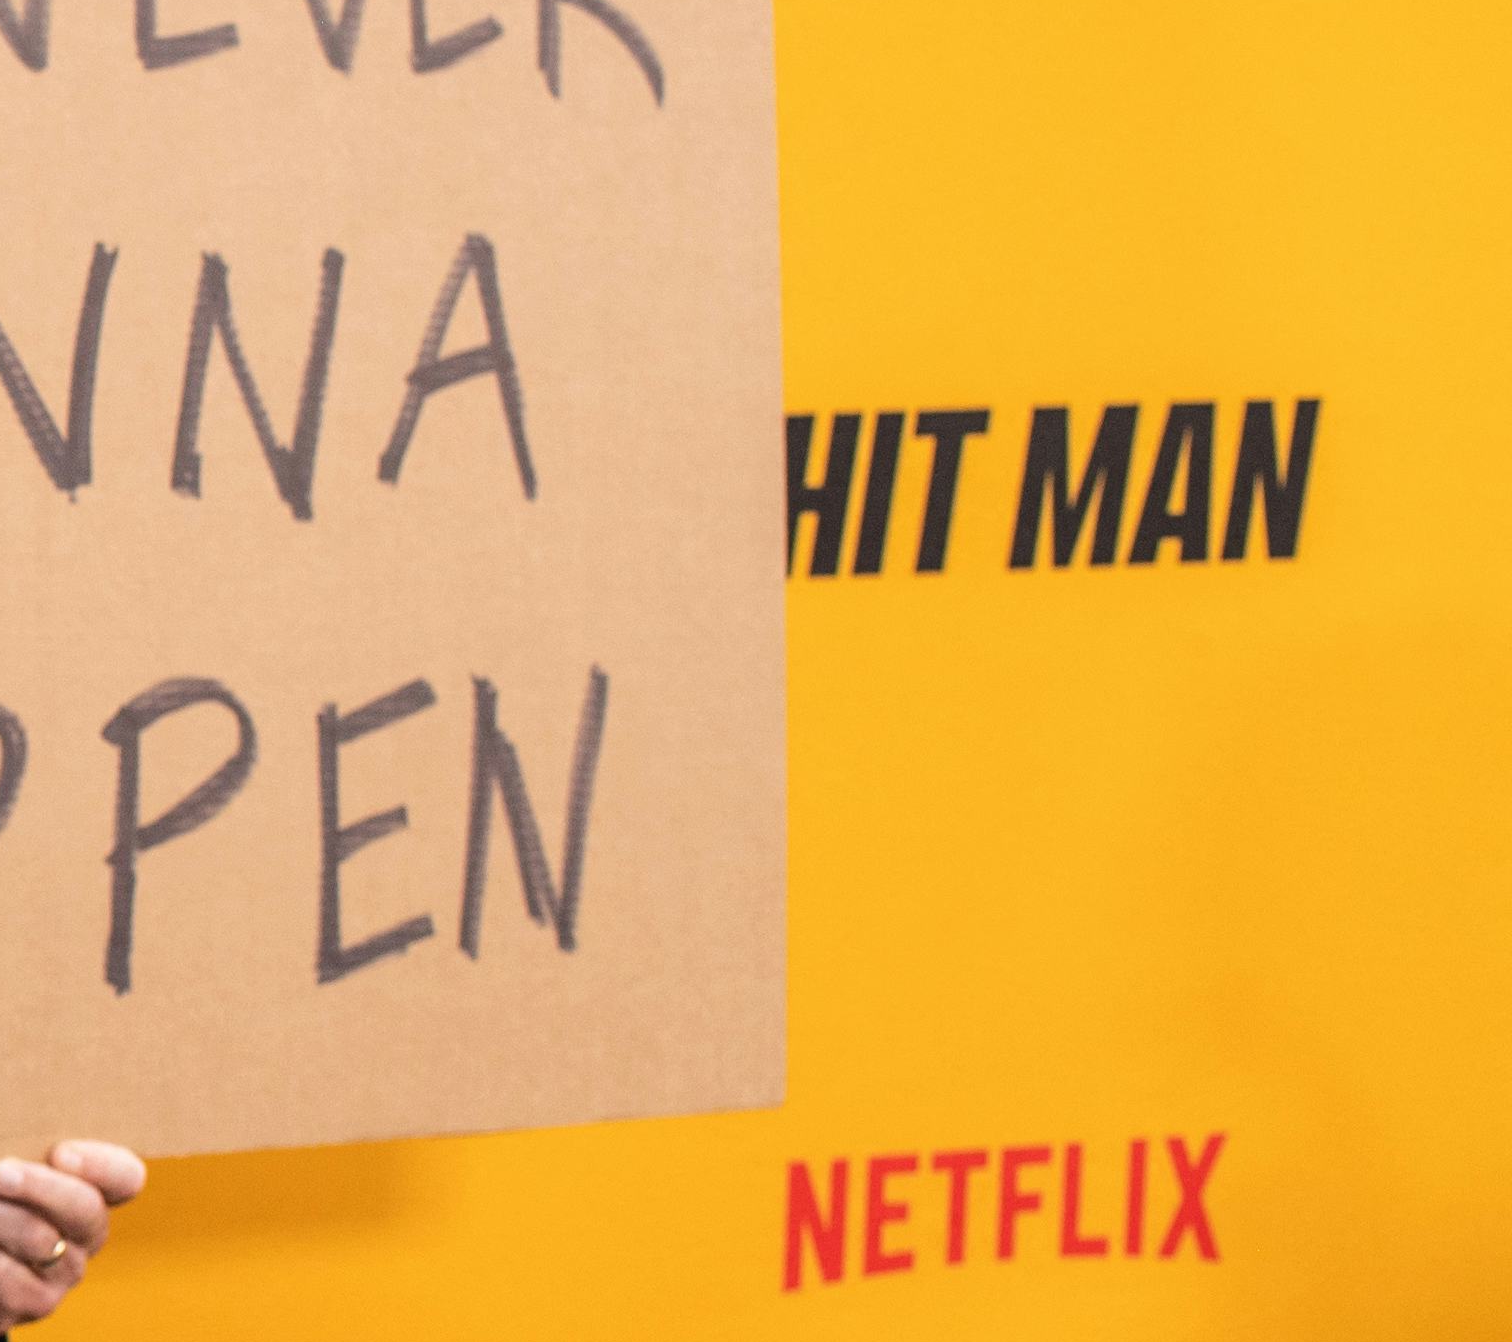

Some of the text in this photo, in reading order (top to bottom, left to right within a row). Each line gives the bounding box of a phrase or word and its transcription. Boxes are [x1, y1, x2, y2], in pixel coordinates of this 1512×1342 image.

[785, 396, 1322, 578] HIT MAN
[781, 1132, 1227, 1294] NETFLIX
